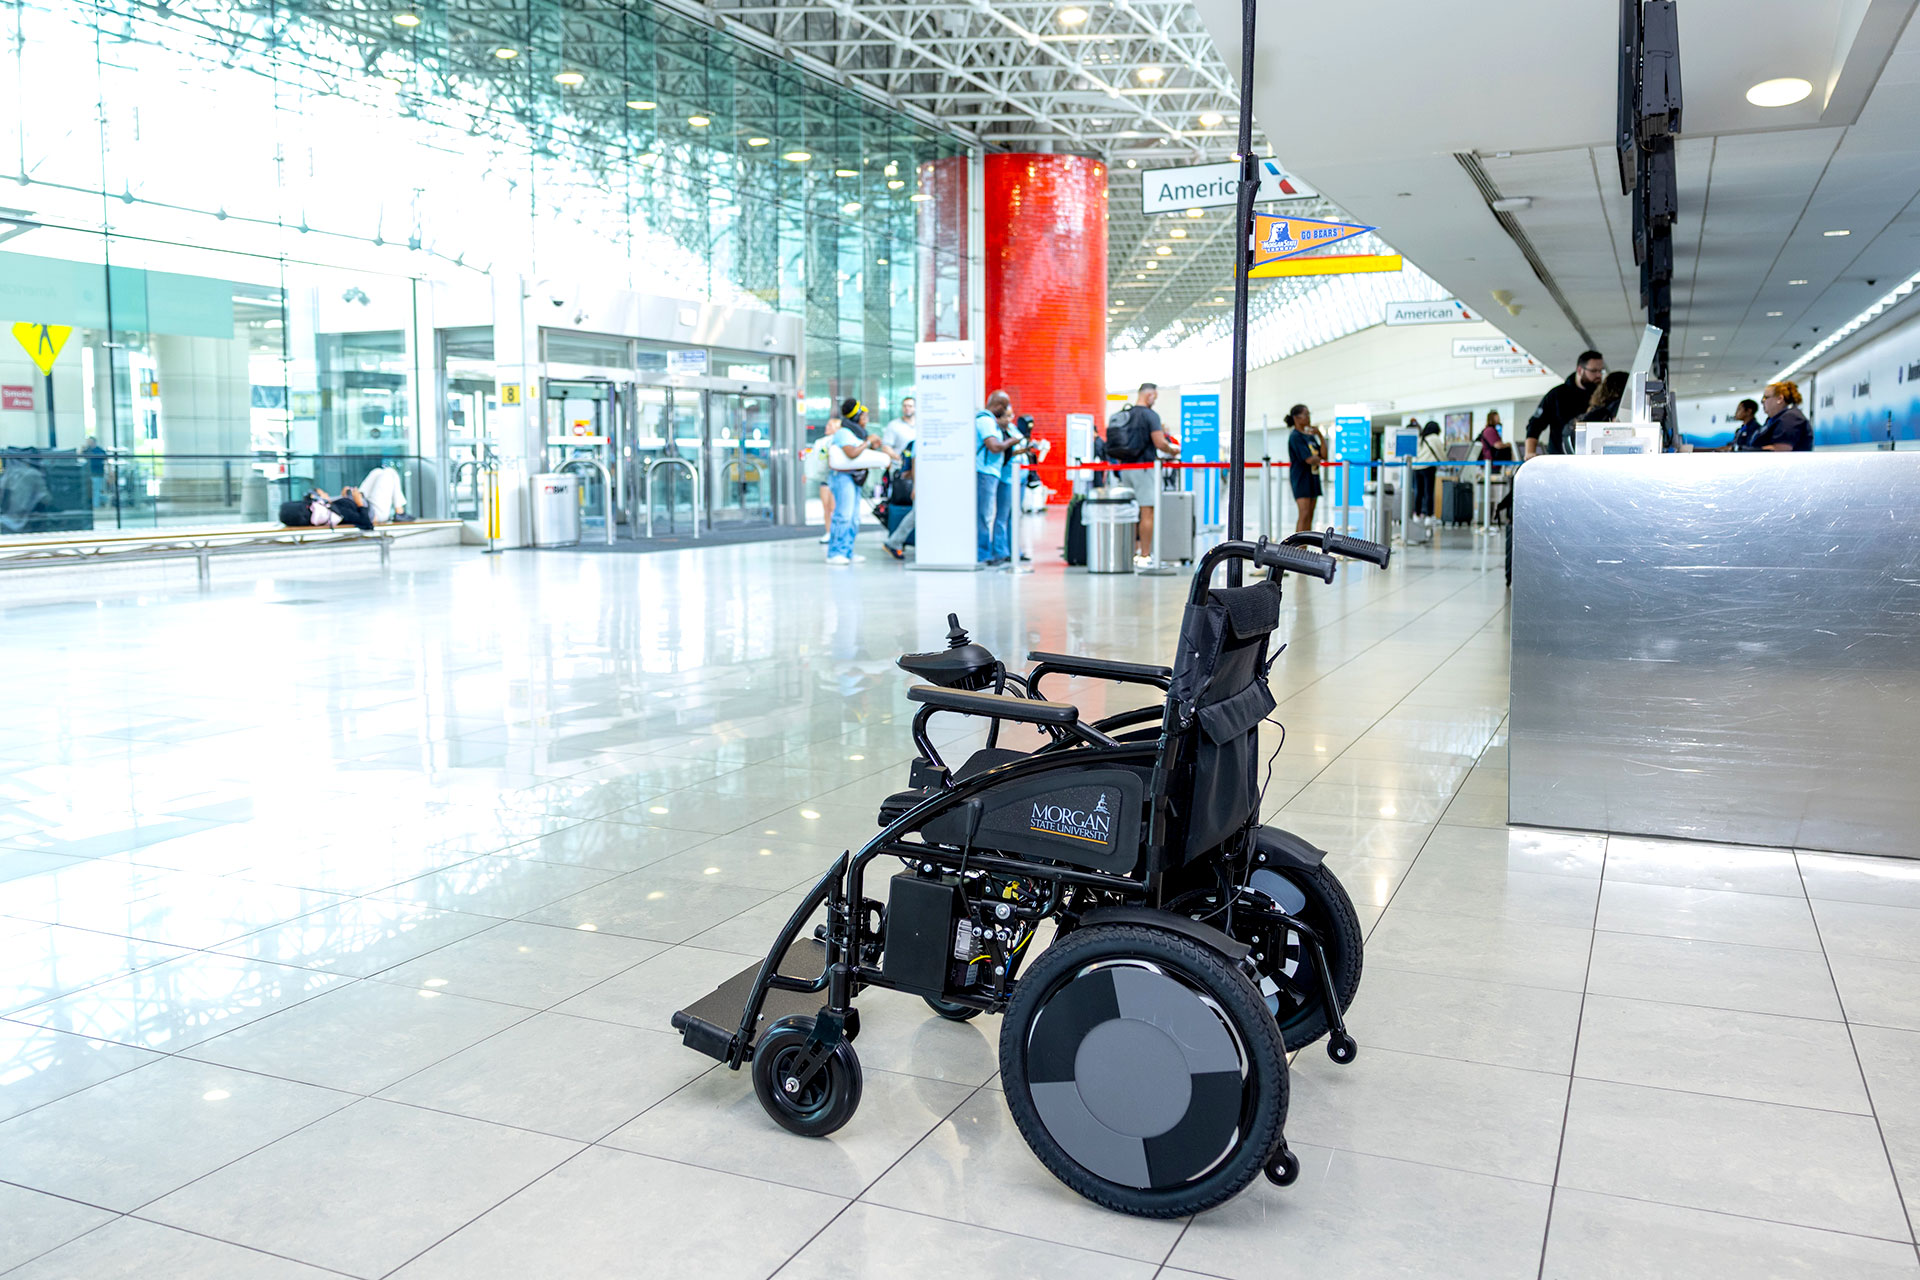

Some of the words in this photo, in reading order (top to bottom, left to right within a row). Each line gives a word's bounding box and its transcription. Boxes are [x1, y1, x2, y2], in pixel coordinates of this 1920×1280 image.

[1158, 177, 1263, 202] Americ
[1300, 230, 1311, 240] GO
[1395, 308, 1453, 320] American
[1459, 343, 1505, 353] American
[1481, 356, 1522, 364] American
[507, 387, 514, 402] 8
[1031, 802, 1111, 832] MORGAN
[1030, 818, 1056, 831] STATE
[1057, 823, 1109, 841] UNIVERSITY
